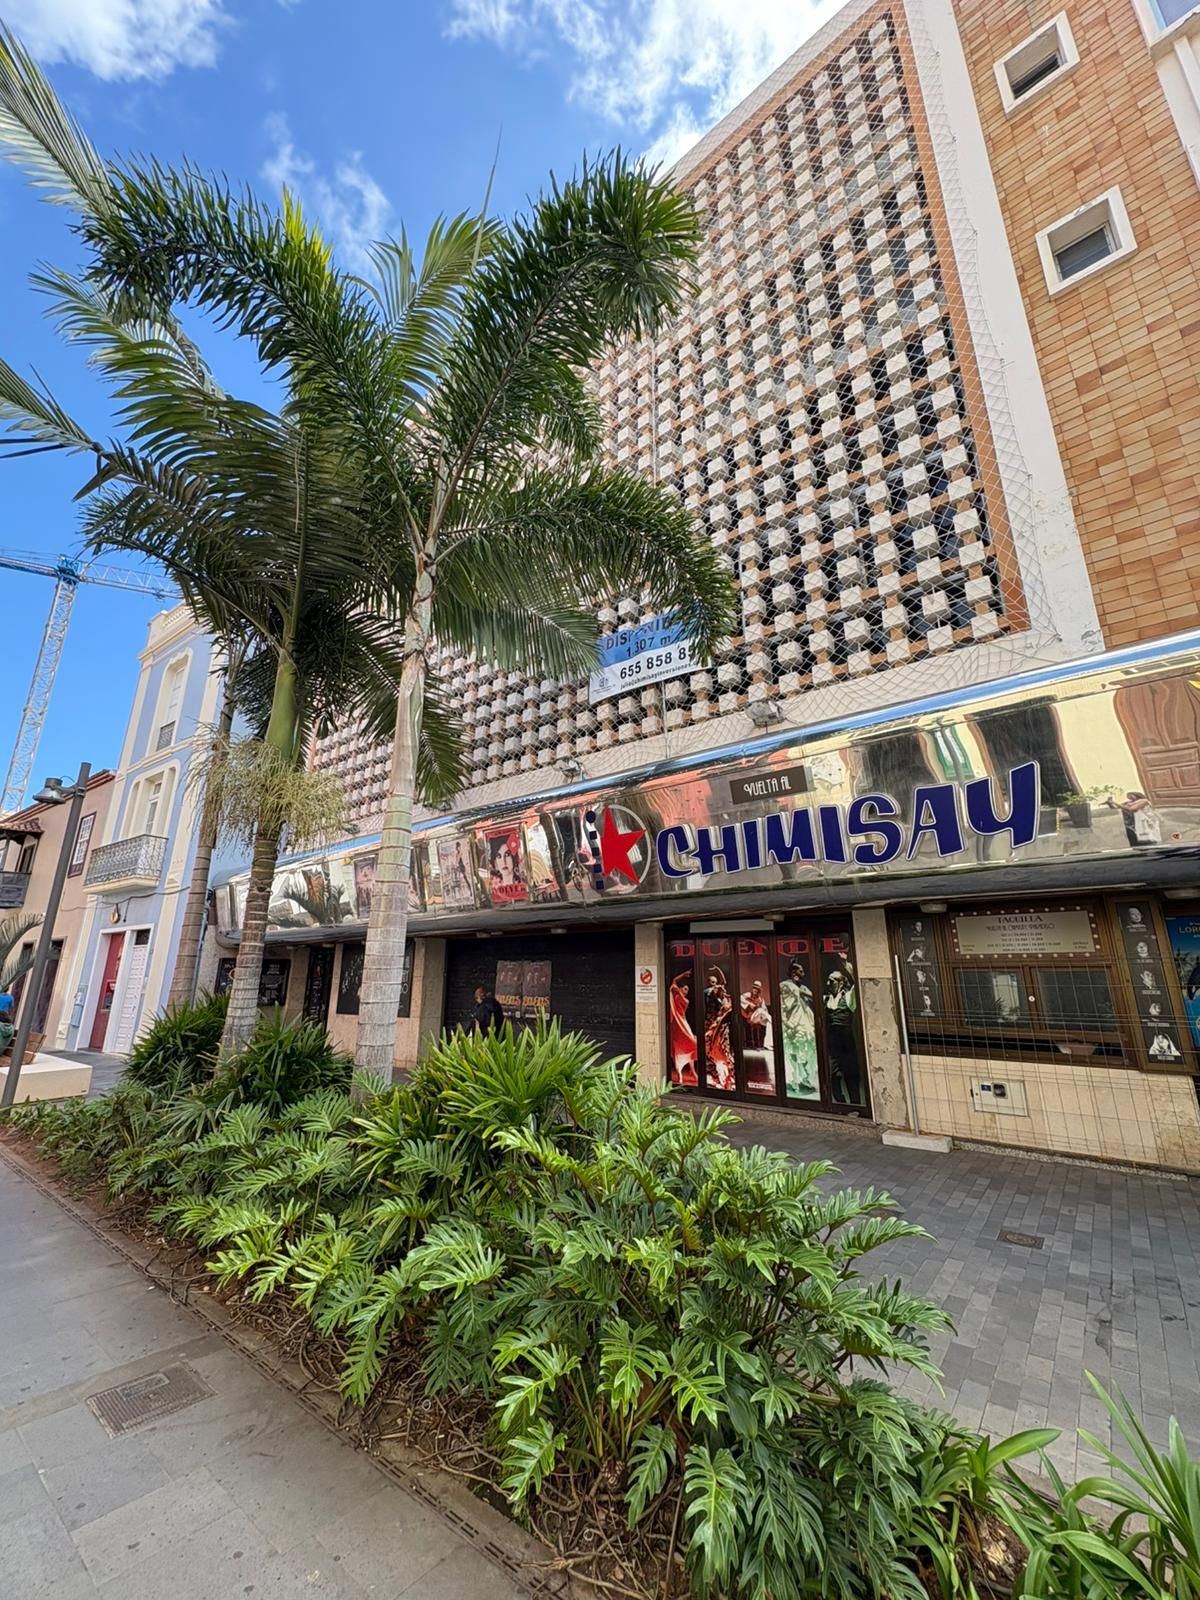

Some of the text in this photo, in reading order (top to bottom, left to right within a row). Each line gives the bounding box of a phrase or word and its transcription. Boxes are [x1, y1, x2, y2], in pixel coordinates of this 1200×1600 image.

[620, 644, 696, 679] 655 858 85
[743, 775, 792, 797] VUELTA AL
[656, 760, 1041, 879] CHIMISAY
